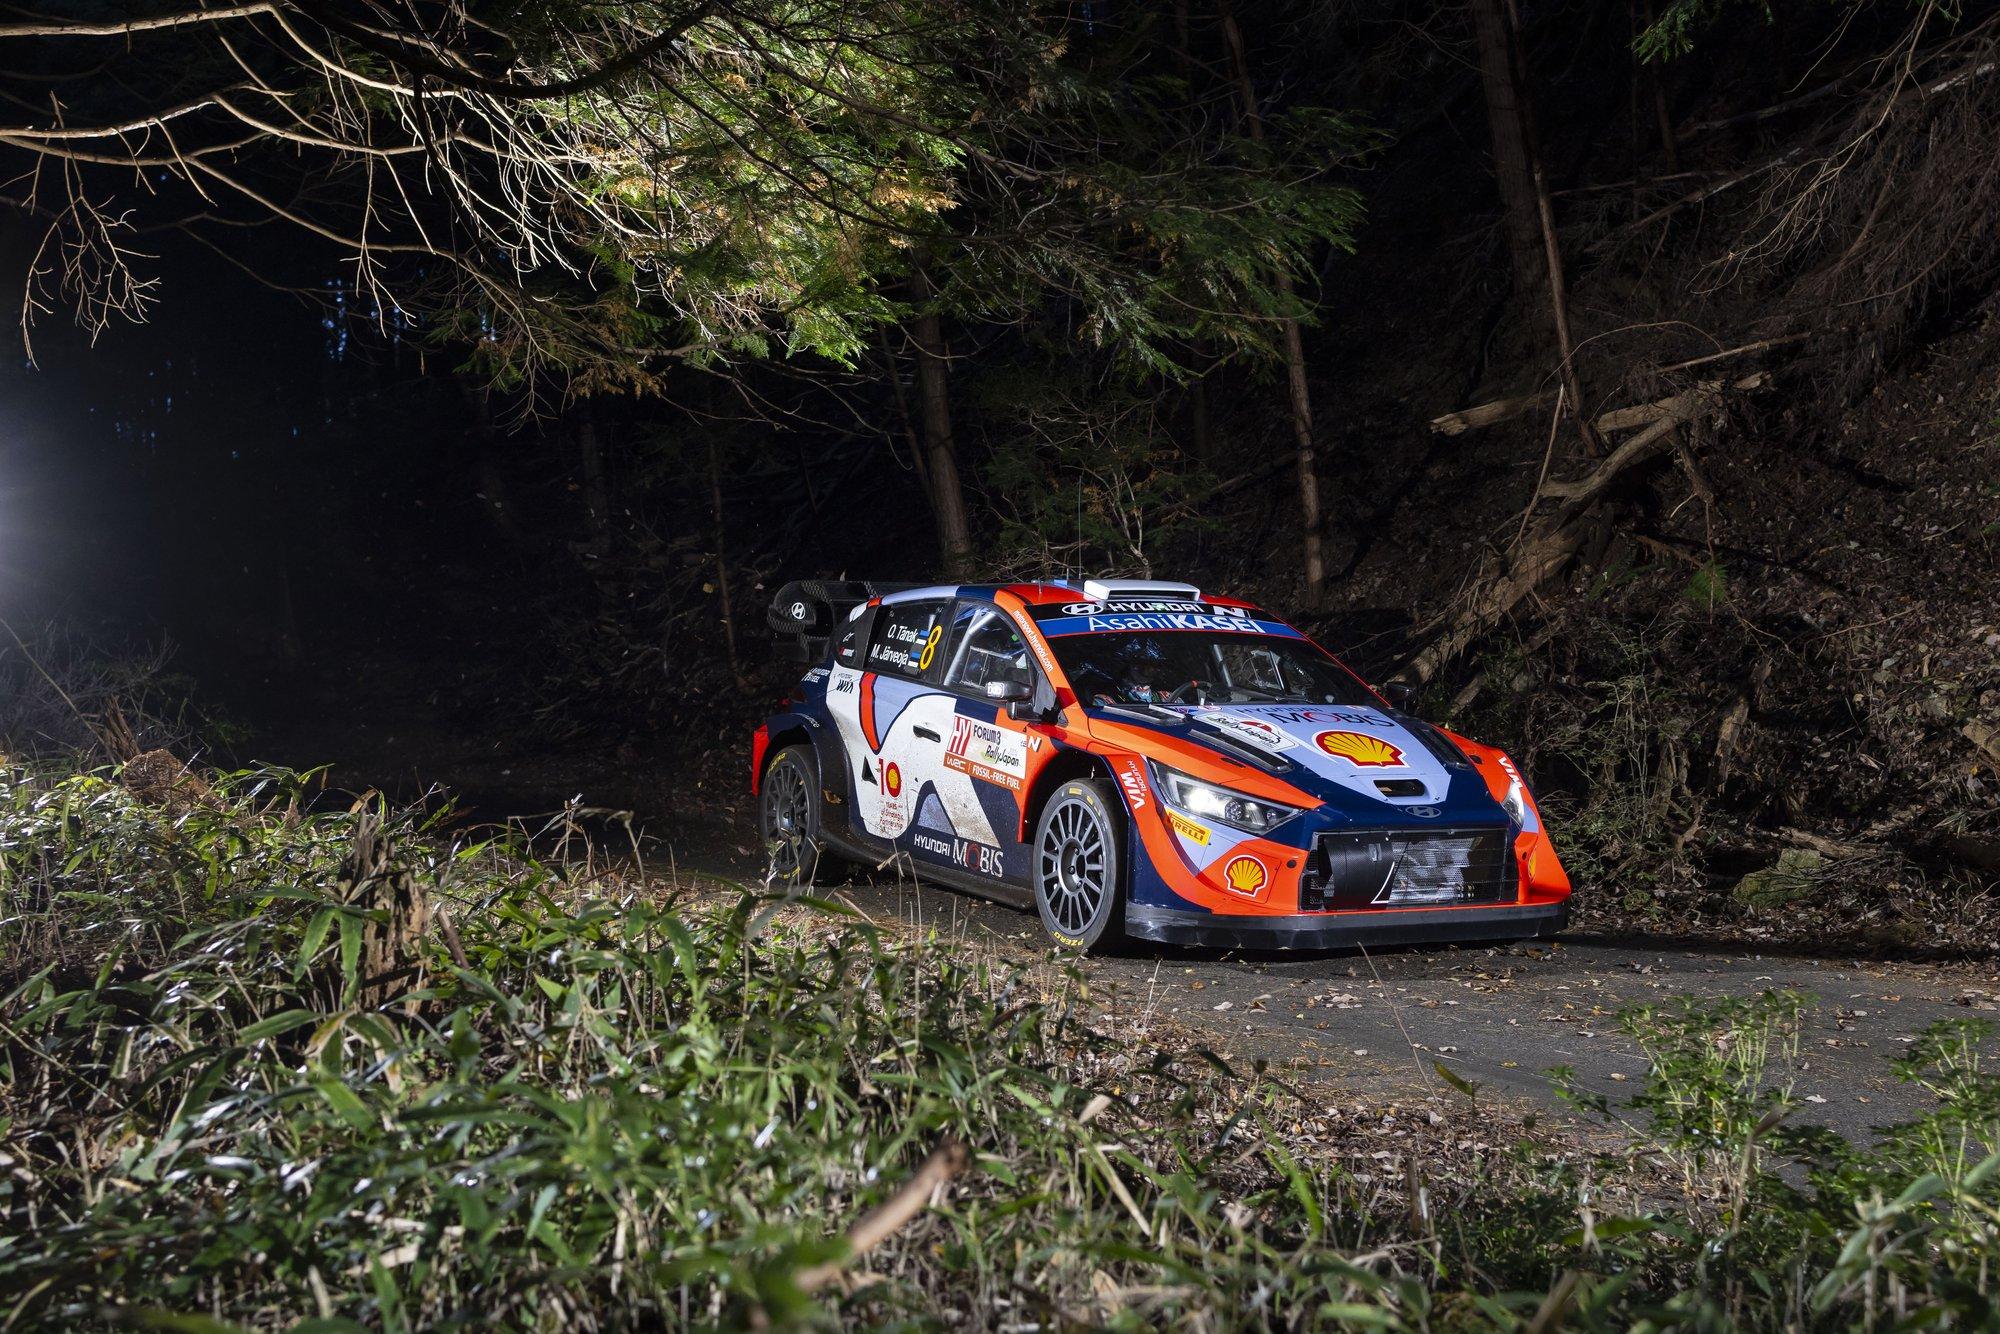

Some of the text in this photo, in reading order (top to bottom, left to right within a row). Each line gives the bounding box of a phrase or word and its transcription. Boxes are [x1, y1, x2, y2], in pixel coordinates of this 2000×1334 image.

[887, 623, 919, 643] O. Tänak
[870, 643, 880, 659] M.
[879, 645, 909, 669] Järveoja
[920, 625, 943, 670] 8
[1267, 711, 1396, 727] MOBIS
[1006, 778, 1020, 790] FUEL
[914, 833, 951, 857] HYUNDAI
[953, 838, 1004, 878] MOBIS
